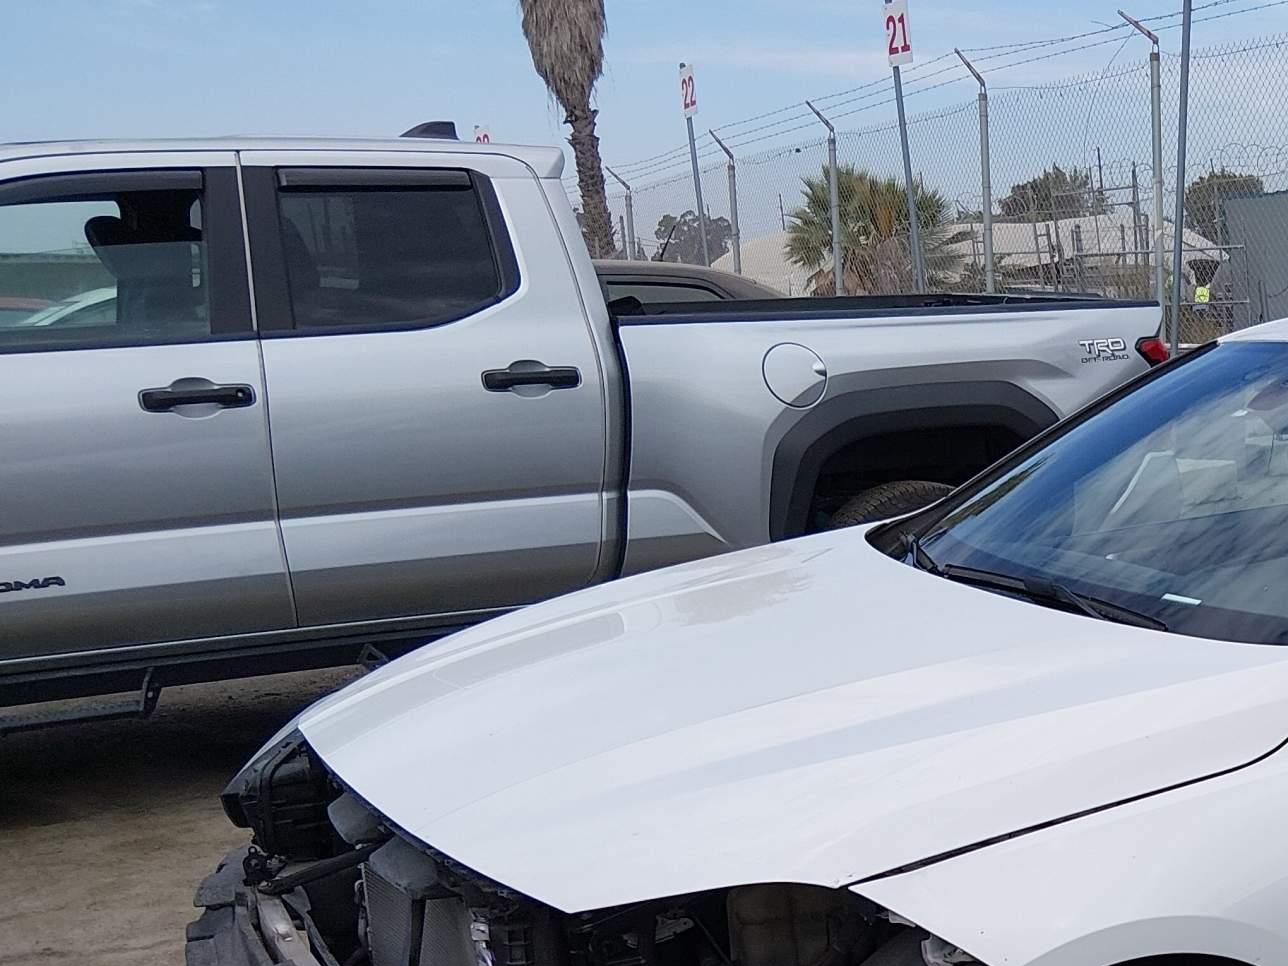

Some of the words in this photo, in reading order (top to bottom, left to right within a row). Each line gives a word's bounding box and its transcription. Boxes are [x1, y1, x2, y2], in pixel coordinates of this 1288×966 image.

[886, 13, 910, 56] 21
[681, 75, 697, 110] 22
[1079, 338, 1126, 357] TRD
